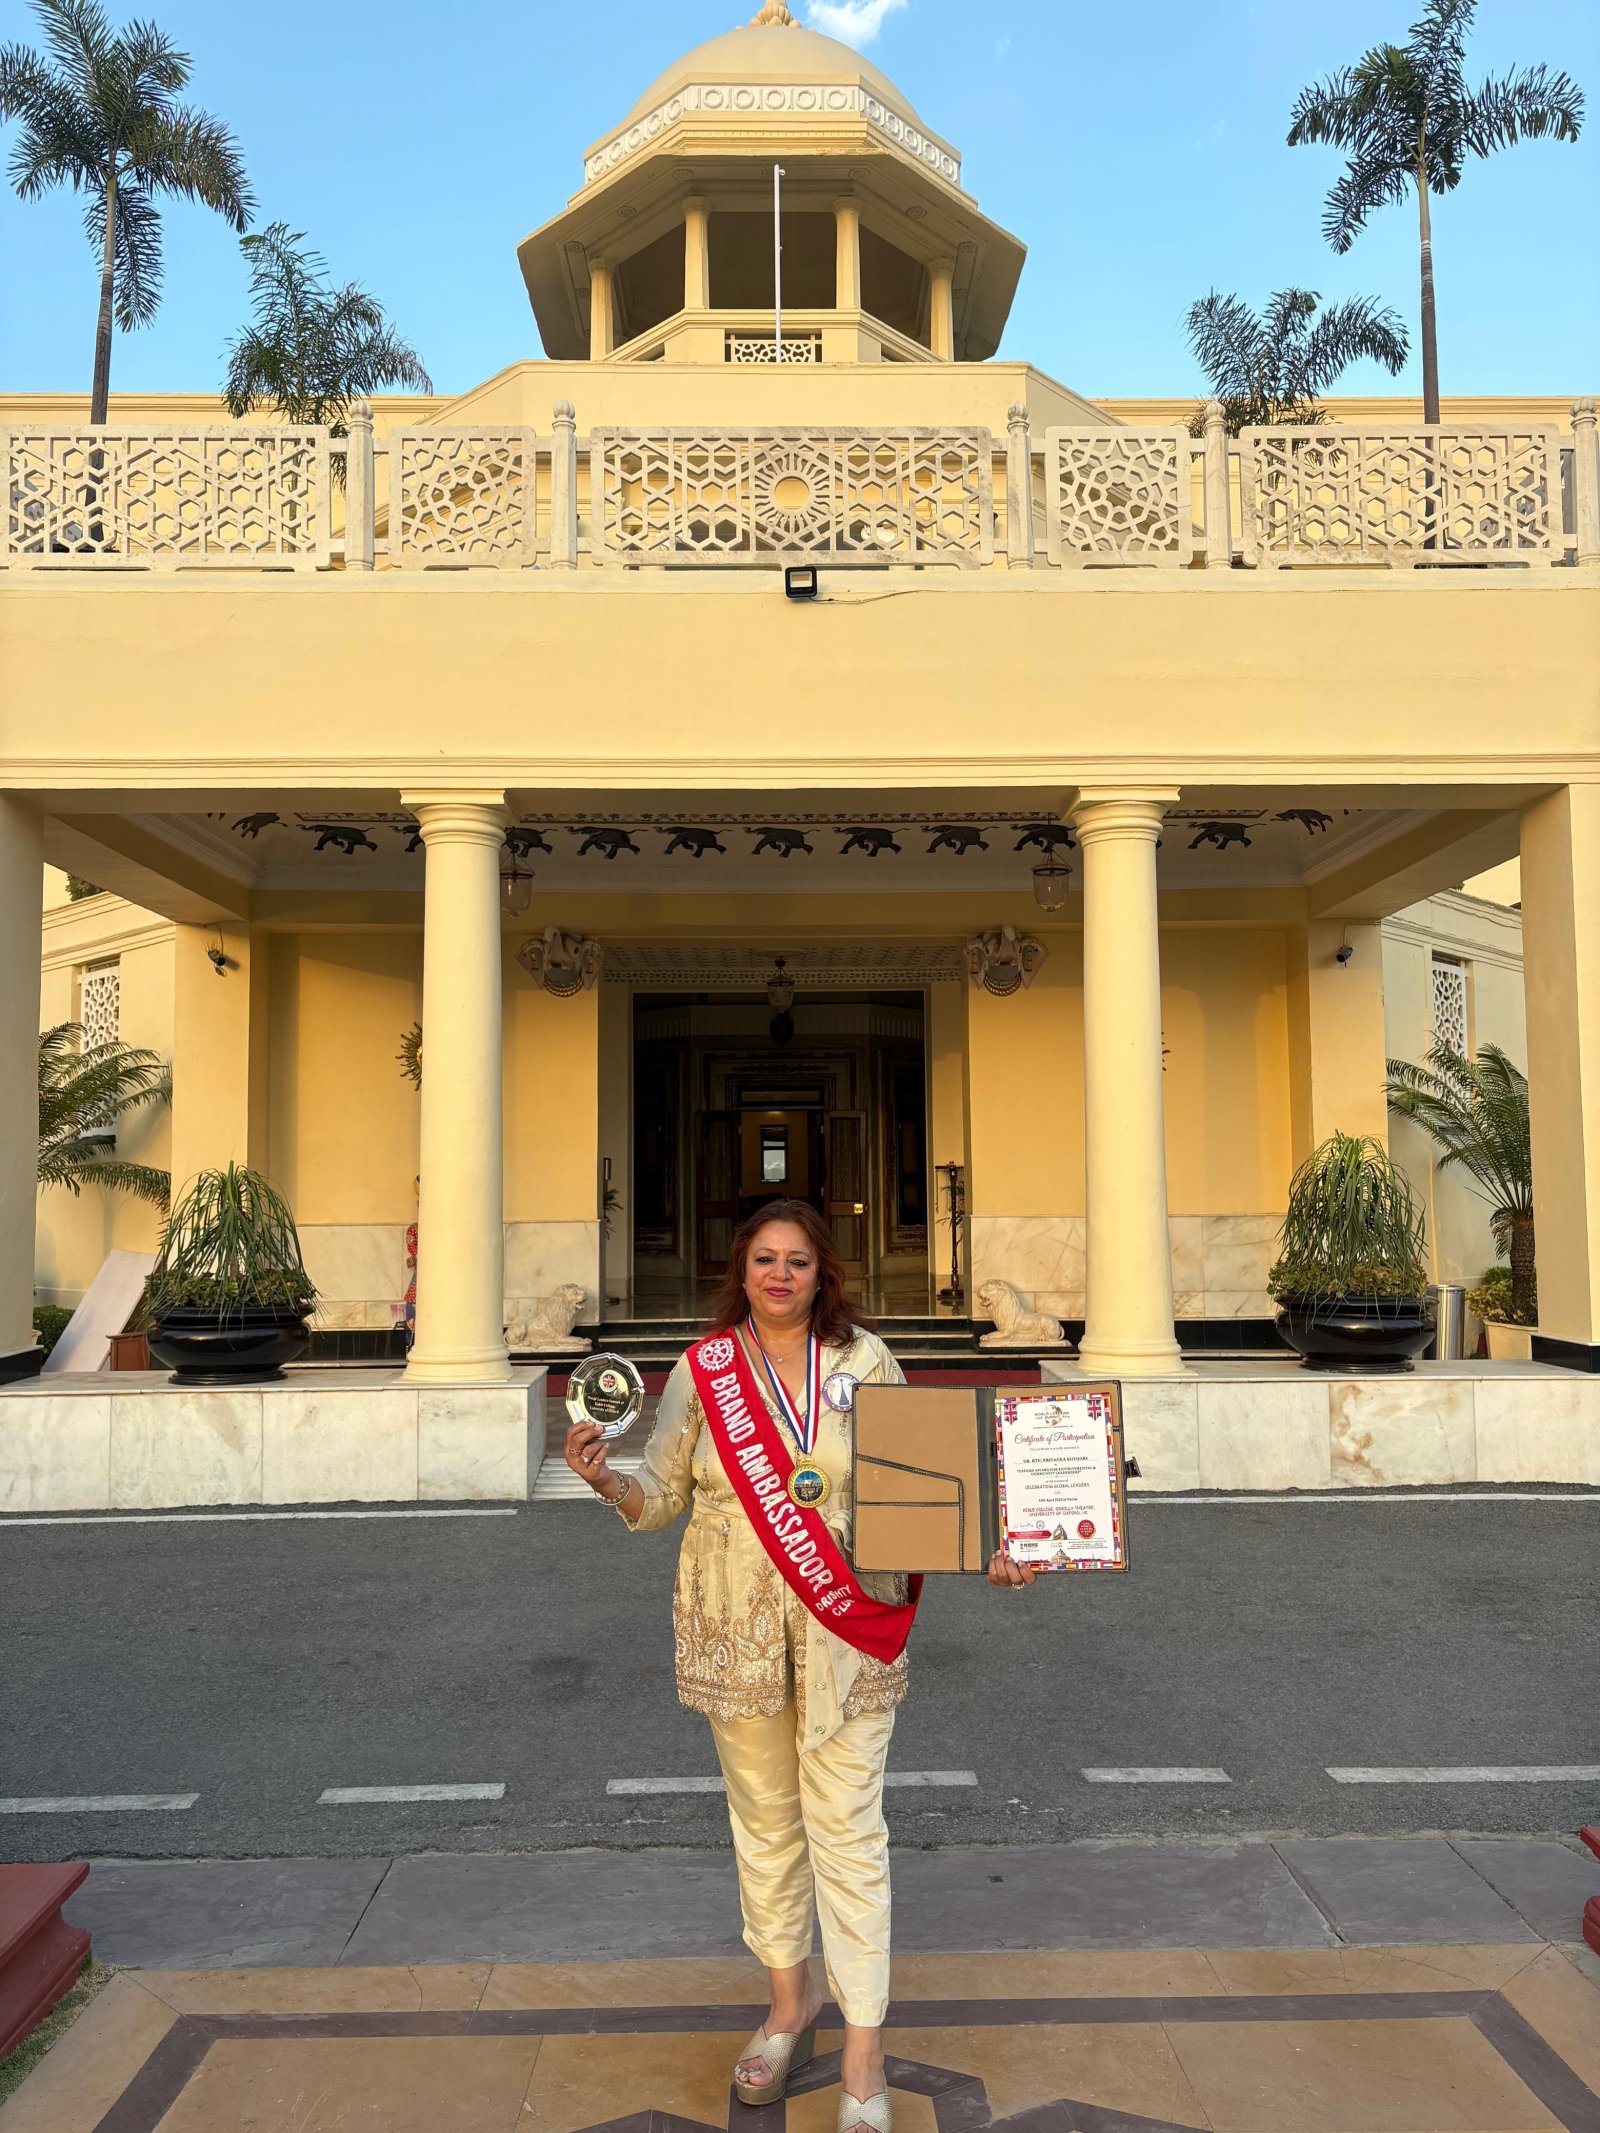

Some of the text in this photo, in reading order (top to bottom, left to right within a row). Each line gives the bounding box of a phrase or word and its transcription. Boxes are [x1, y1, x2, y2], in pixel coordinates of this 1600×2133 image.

[1014, 1432, 1095, 1446] Certificate of Participation
[710, 1371, 757, 1444] BRAND
[736, 1443, 834, 1594] AMBASSADOR
[814, 1584, 852, 1612] DRISHTY
